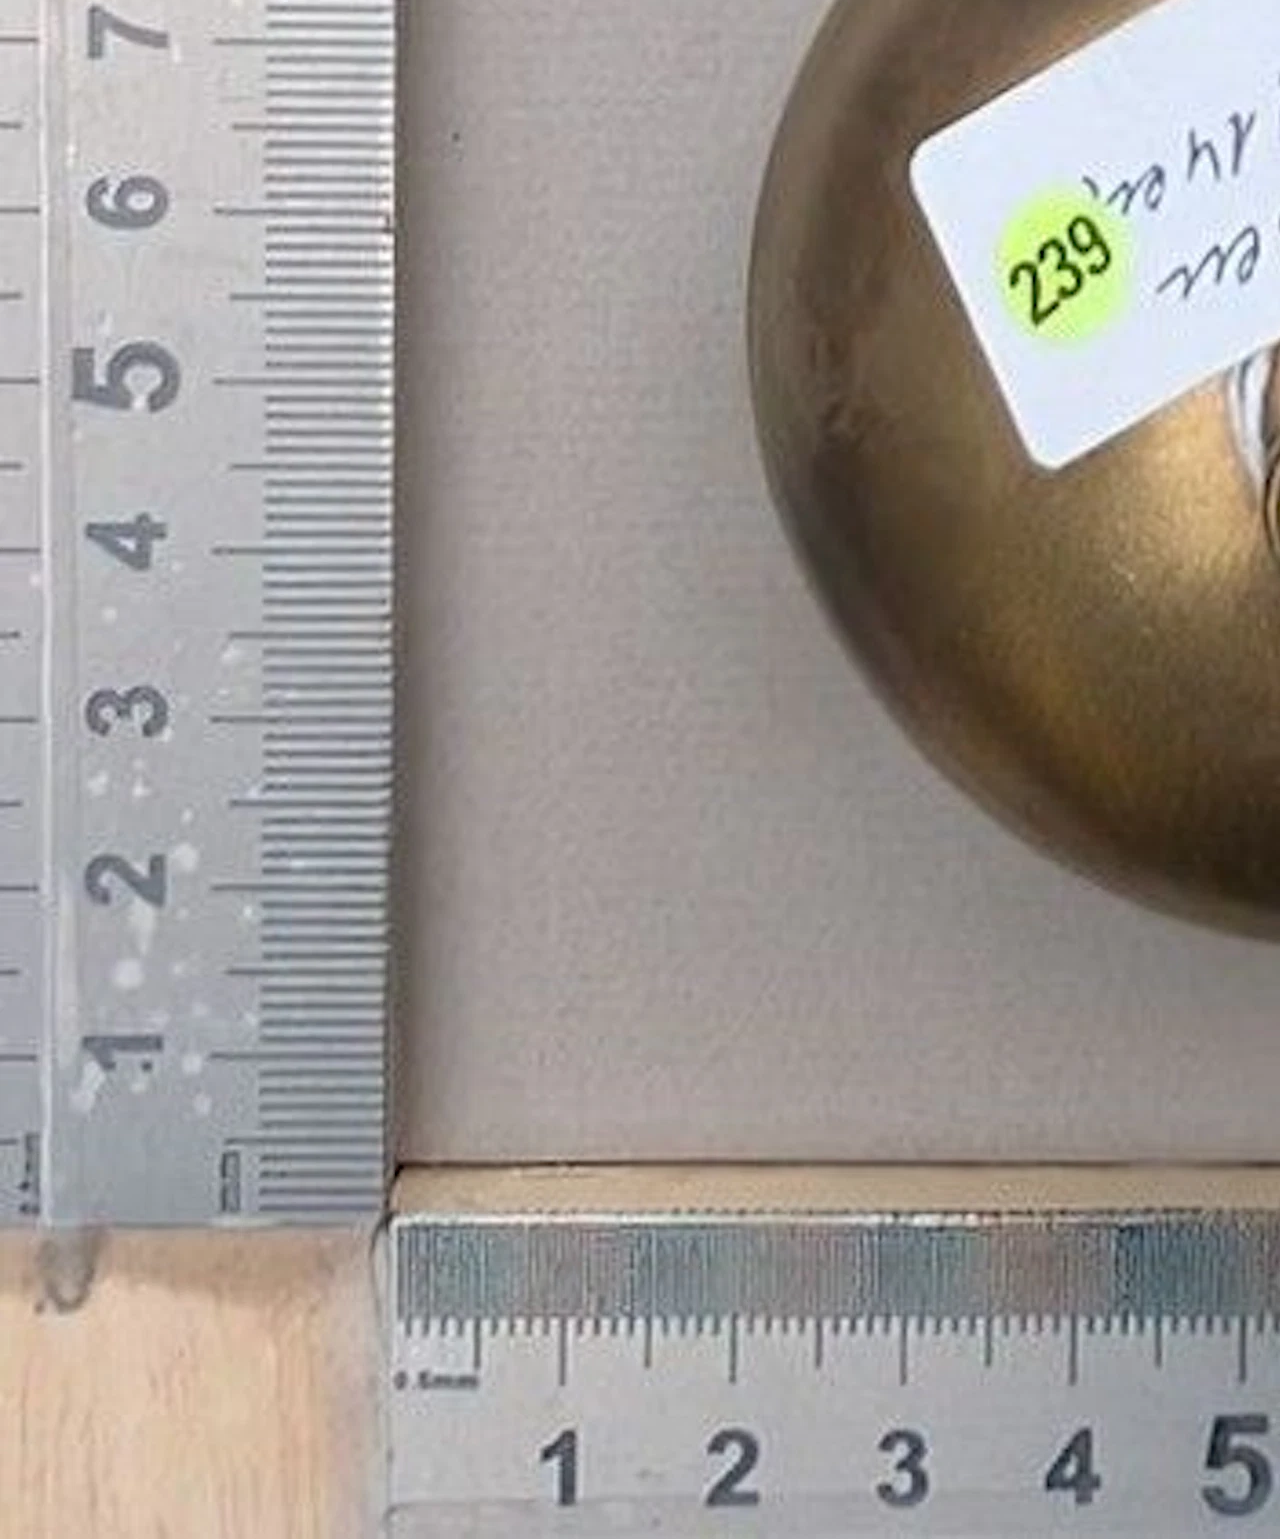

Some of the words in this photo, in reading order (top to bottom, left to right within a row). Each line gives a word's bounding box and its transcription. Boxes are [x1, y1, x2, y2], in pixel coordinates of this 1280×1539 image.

[88, 6, 168, 59] 7
[87, 177, 168, 228] 6
[1007, 214, 1113, 327] 239
[72, 342, 180, 412] 5
[85, 514, 167, 570] 4
[86, 687, 167, 737] 3
[84, 855, 165, 906] 2
[82, 1035, 163, 1071] 1
[541, 1429, 577, 1507] 1
[706, 1429, 760, 1507] 2
[877, 1429, 929, 1507] 3
[1045, 1428, 1101, 1504] 4
[1202, 1415, 1272, 1516] 5
